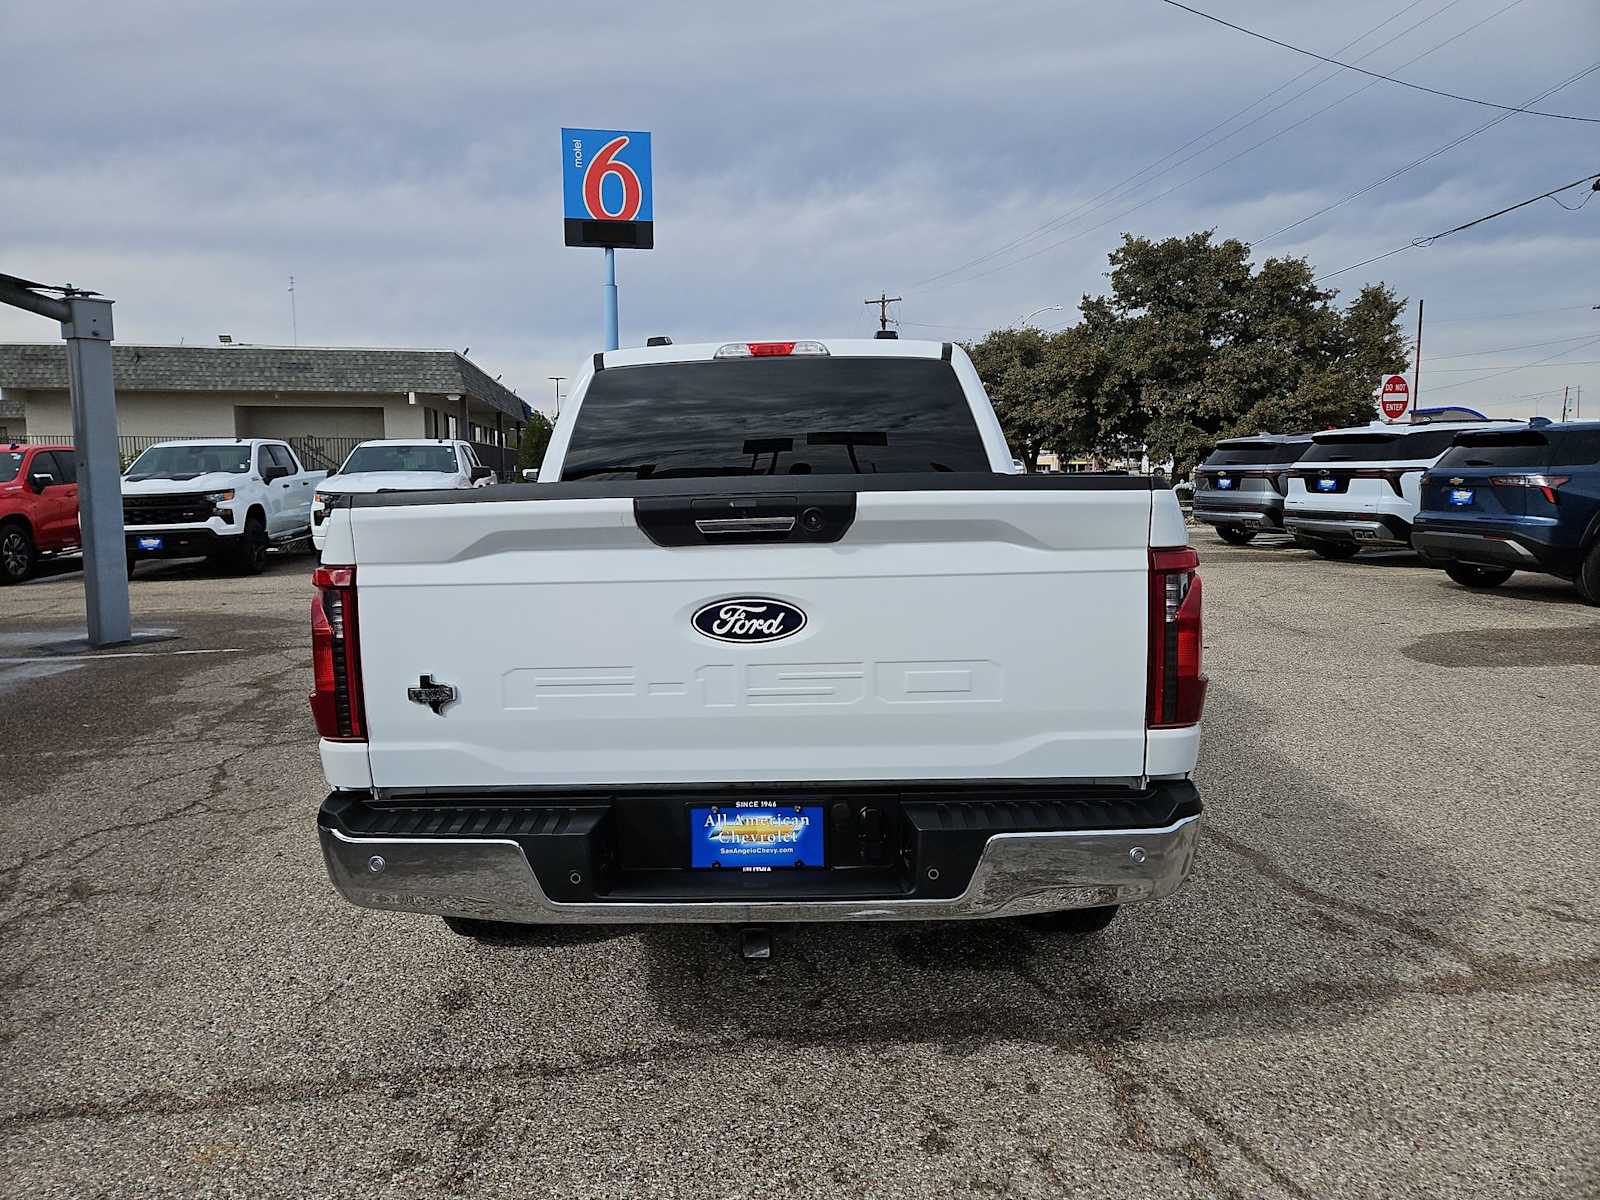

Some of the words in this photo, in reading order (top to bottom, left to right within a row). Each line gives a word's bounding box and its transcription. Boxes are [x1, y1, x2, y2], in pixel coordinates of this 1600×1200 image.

[573, 139, 582, 168] motel
[583, 136, 642, 221] 6
[1386, 403, 1403, 411] ENTER
[712, 605, 785, 634] Ford
[502, 660, 1003, 711] F-150
[704, 813, 727, 827] All
[734, 813, 810, 826] American
[719, 830, 798, 844] Chevrolet
[720, 847, 794, 855] SanAngeloChevy.com
